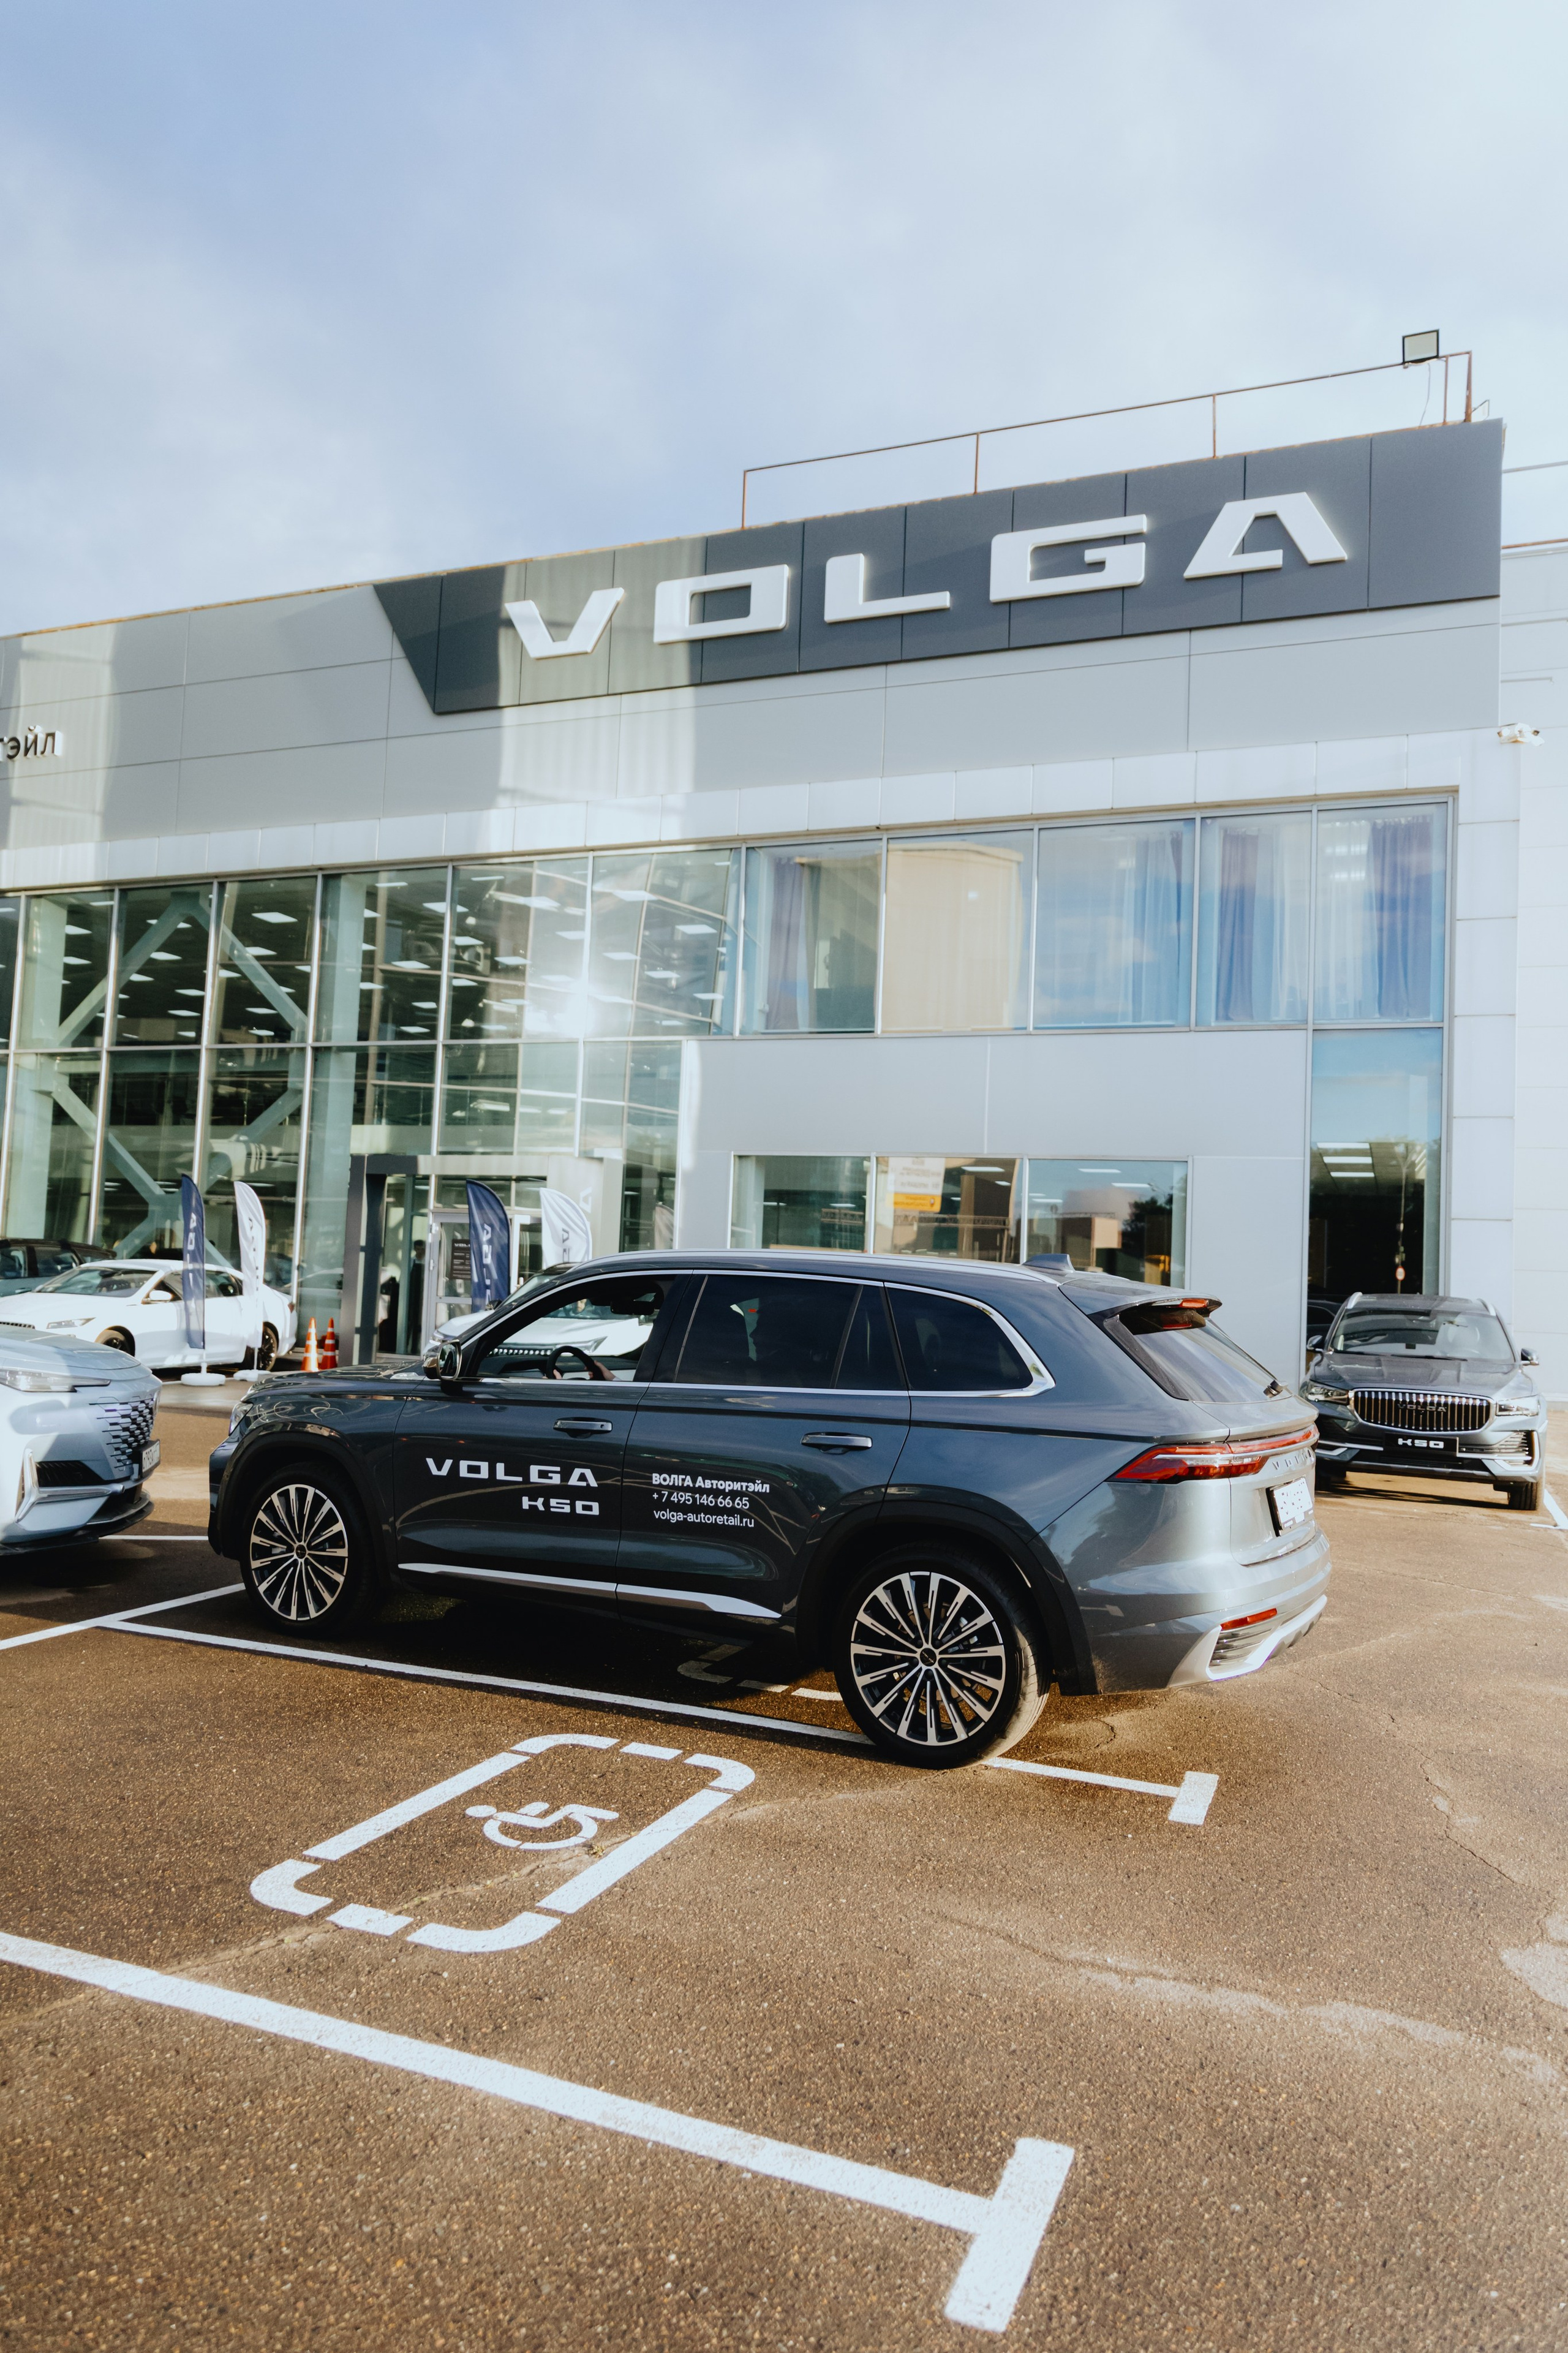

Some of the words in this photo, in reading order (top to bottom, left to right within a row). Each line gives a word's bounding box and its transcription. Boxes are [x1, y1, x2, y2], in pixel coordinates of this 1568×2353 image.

[504, 492, 1348, 659] VOLGA
[1398, 1438, 1444, 1449] K50
[426, 1457, 598, 1487] VOLGA
[652, 1473, 693, 1487] ВОЛГА
[695, 1476, 770, 1493] Авторитэйл
[522, 1496, 600, 1516] K50
[670, 1492, 693, 1505] 495
[695, 1494, 715, 1506] 146
[717, 1495, 733, 1508] 66
[734, 1497, 750, 1509] 65
[654, 1508, 755, 1528] volga-autoretail.ru
